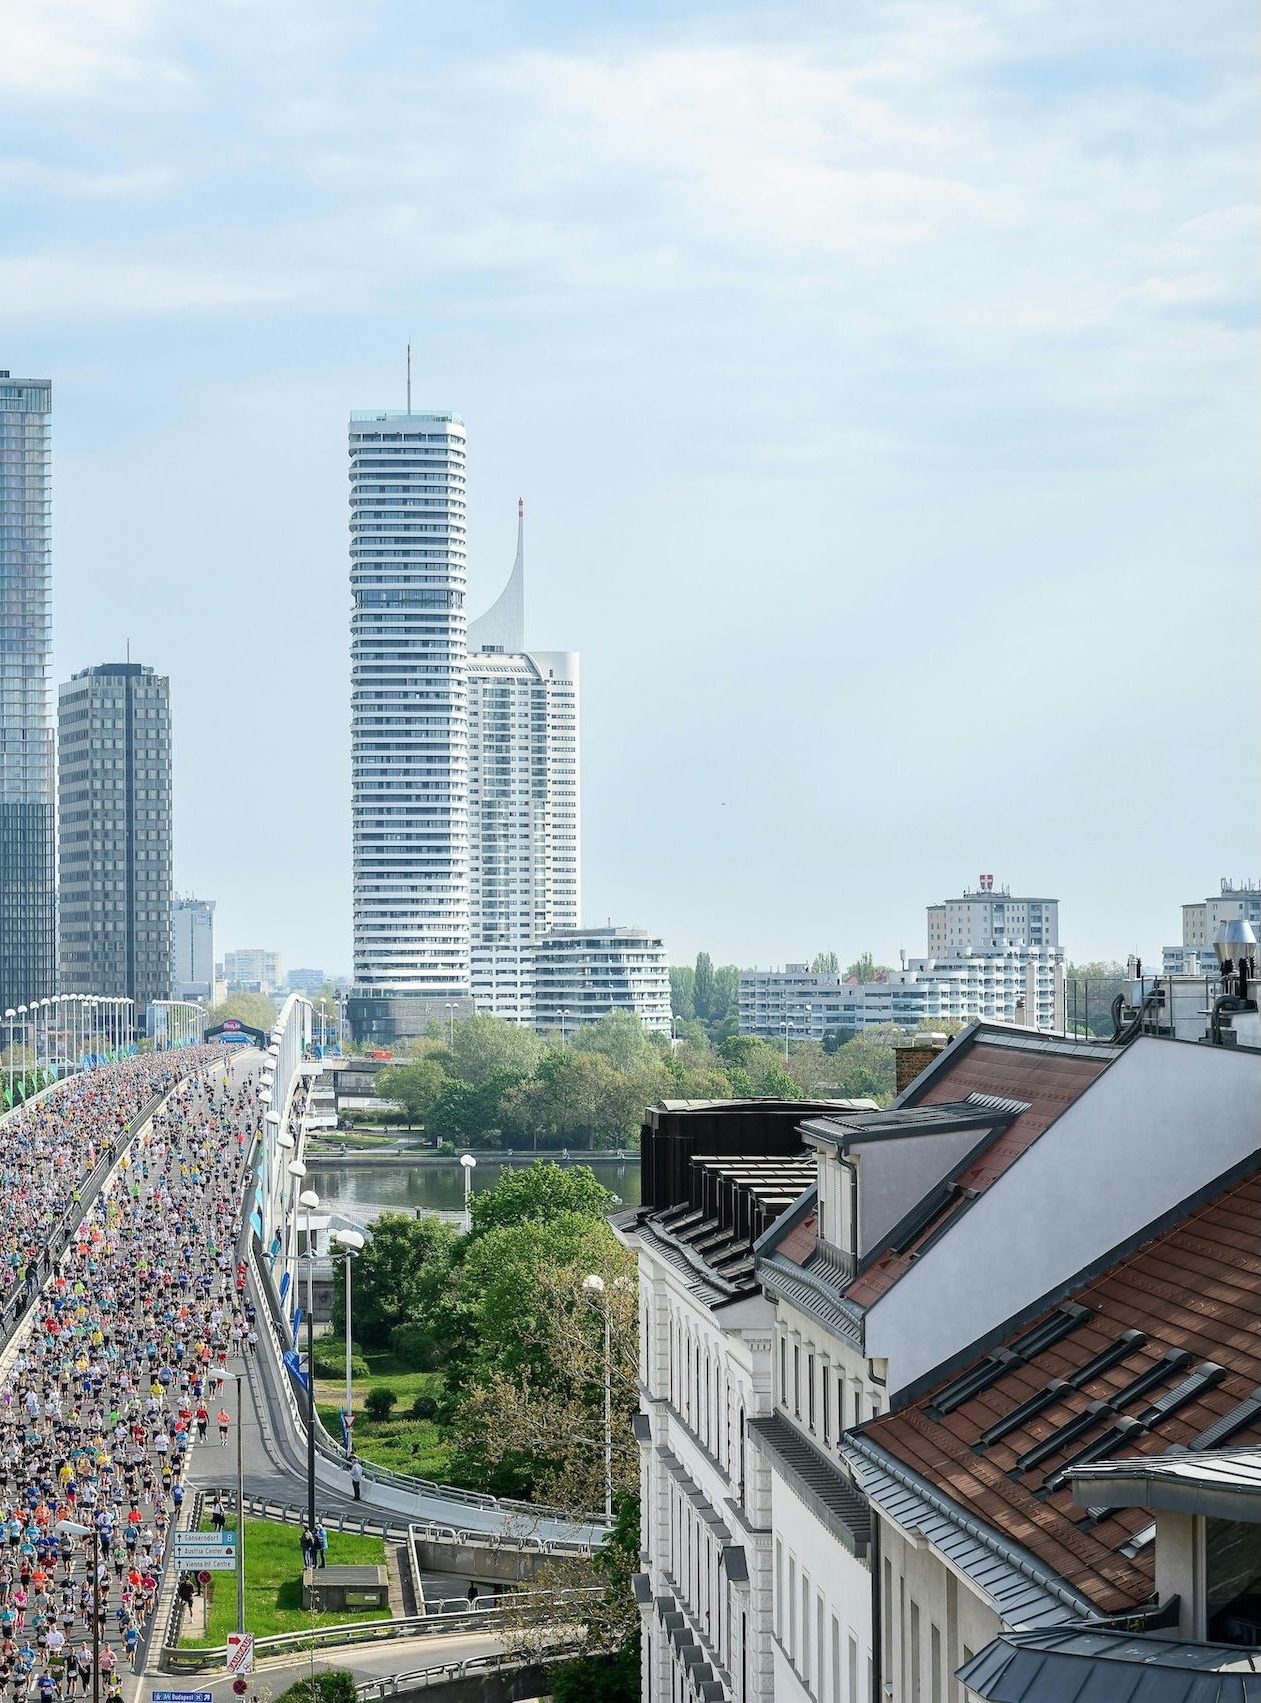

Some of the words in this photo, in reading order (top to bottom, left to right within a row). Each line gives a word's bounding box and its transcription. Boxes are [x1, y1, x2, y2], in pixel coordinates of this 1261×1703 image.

[227, 1534, 232, 1542] 8
[227, 1634, 253, 1673] BAUHAUS
[172, 1693, 194, 1701] Budapest
